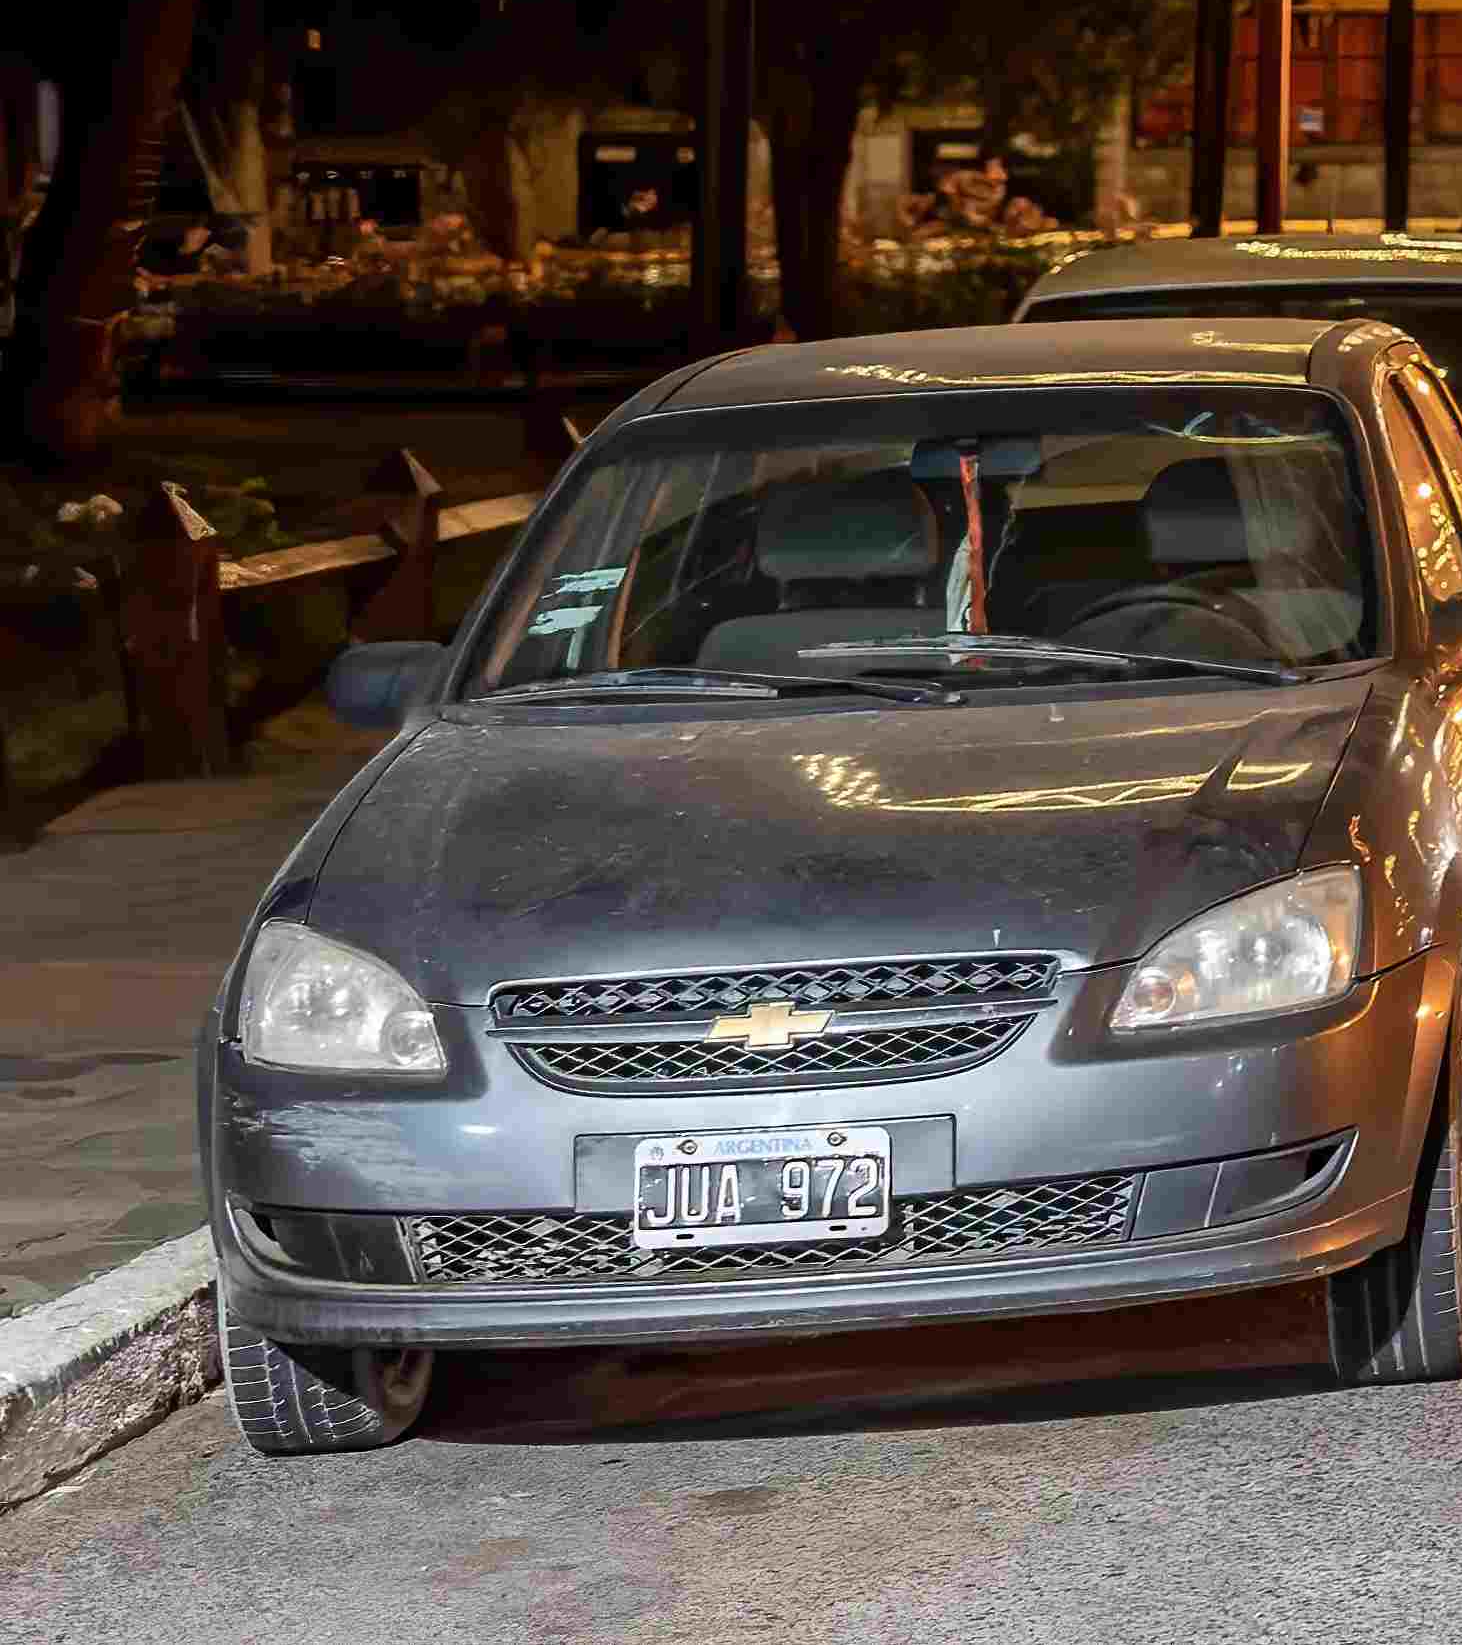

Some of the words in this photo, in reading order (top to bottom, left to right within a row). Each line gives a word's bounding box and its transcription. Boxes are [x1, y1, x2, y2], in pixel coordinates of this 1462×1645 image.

[713, 1137, 812, 1155] ARGENTINA
[646, 1164, 740, 1225] JUA
[781, 1156, 880, 1219] 972
